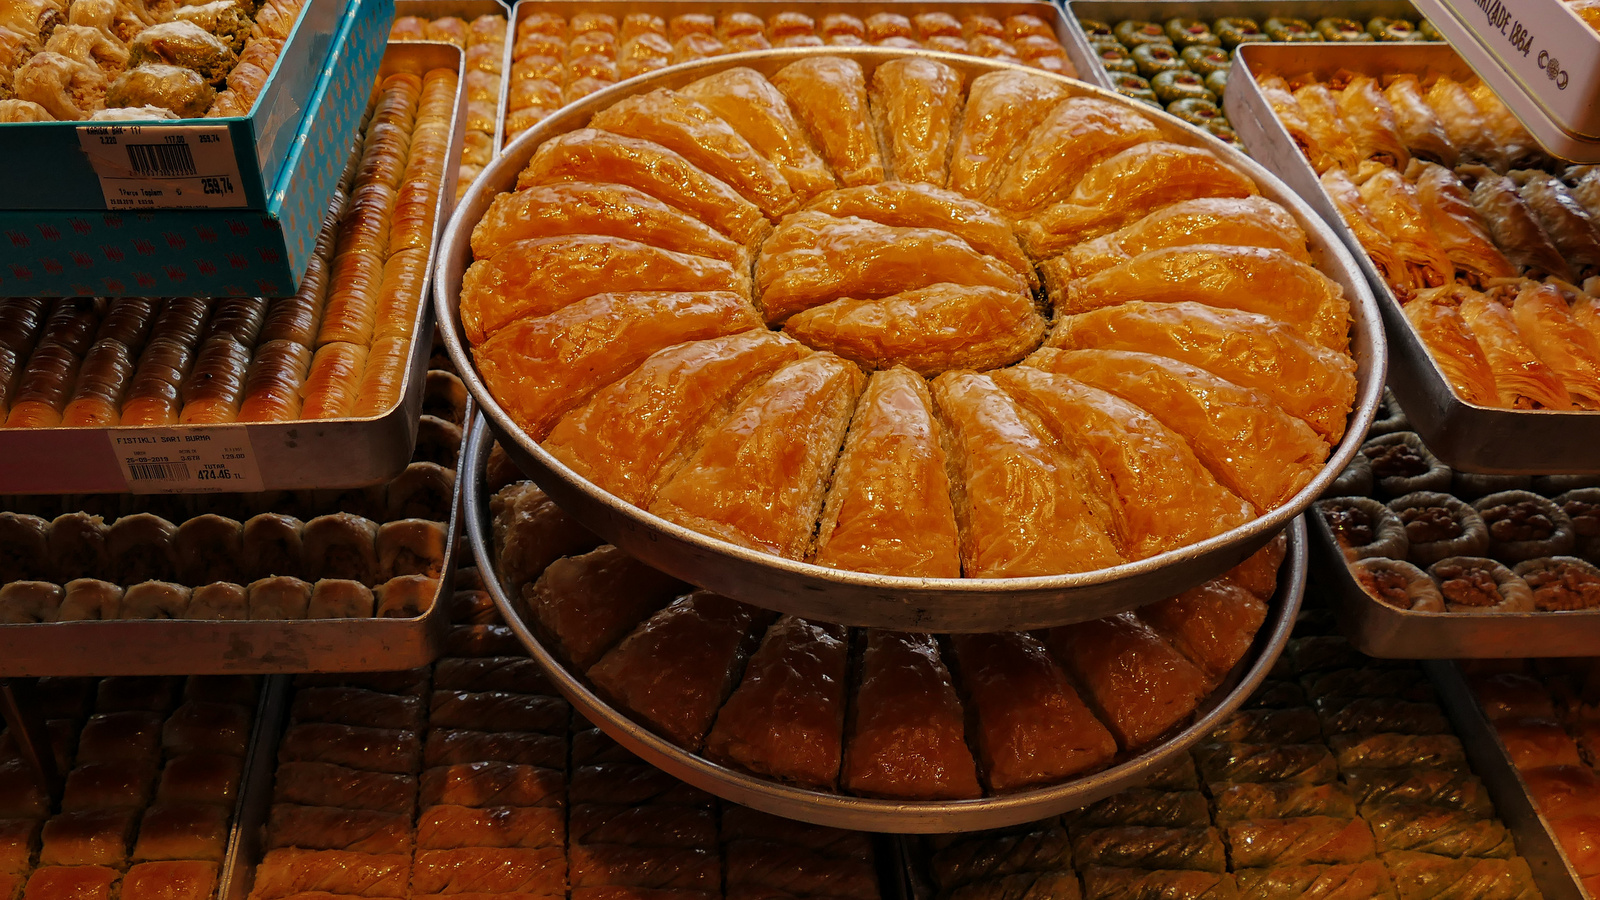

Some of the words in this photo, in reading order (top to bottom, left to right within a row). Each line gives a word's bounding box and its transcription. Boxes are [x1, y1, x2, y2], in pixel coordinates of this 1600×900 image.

[1508, 20, 1534, 57] 1864
[202, 177, 233, 197] 259,74
[198, 469, 231, 480] 474.46
